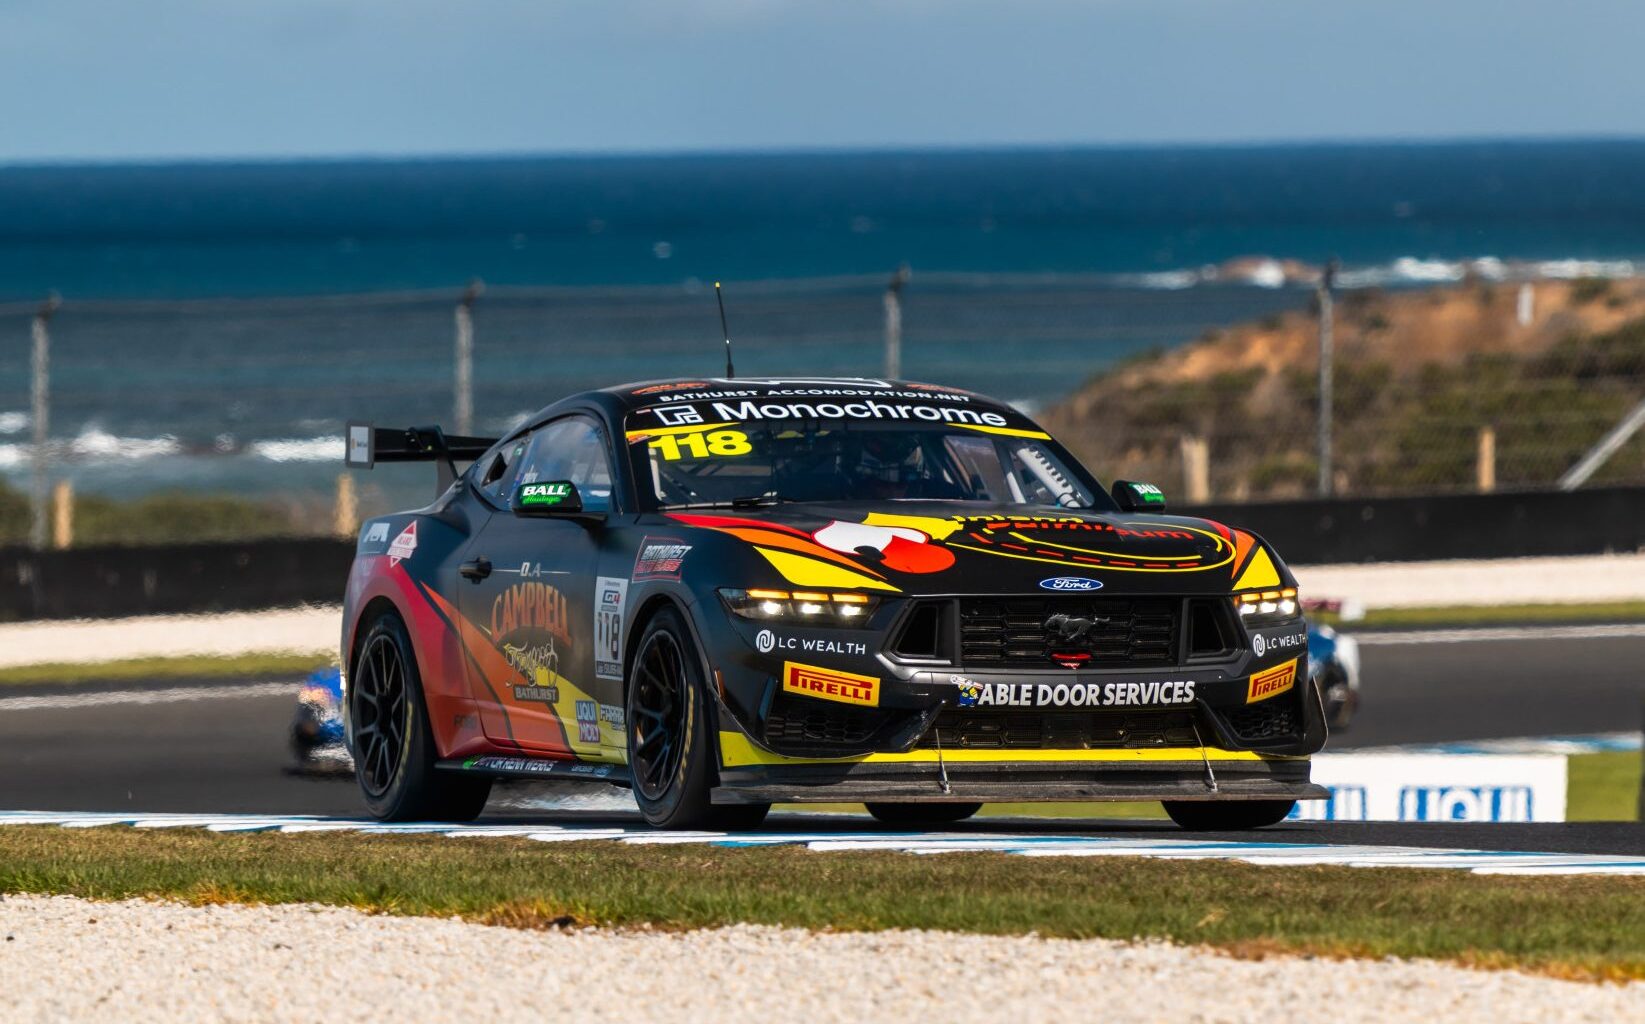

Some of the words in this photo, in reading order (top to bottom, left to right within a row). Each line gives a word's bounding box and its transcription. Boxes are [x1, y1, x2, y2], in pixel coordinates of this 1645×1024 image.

[659, 390, 758, 402] BATHURST
[712, 401, 1007, 427] Monochrome
[648, 430, 753, 461] 118
[522, 485, 567, 497] BALL
[1053, 579, 1091, 588] Ford
[491, 582, 573, 648] CAMPBELL
[778, 637, 797, 649] LC
[803, 639, 866, 655] WEALTH
[1266, 637, 1277, 649] LC
[1279, 633, 1306, 648] WEALTH
[789, 666, 873, 701] PIRELLI
[1251, 665, 1294, 698] PIRELLI
[515, 686, 556, 700] BATHURST
[978, 683, 1032, 706] ABLE
[1036, 684, 1100, 706] DOOR
[1103, 681, 1196, 706] SERVICES
[576, 701, 596, 721] LIQUI
[580, 722, 600, 742] MOLY
